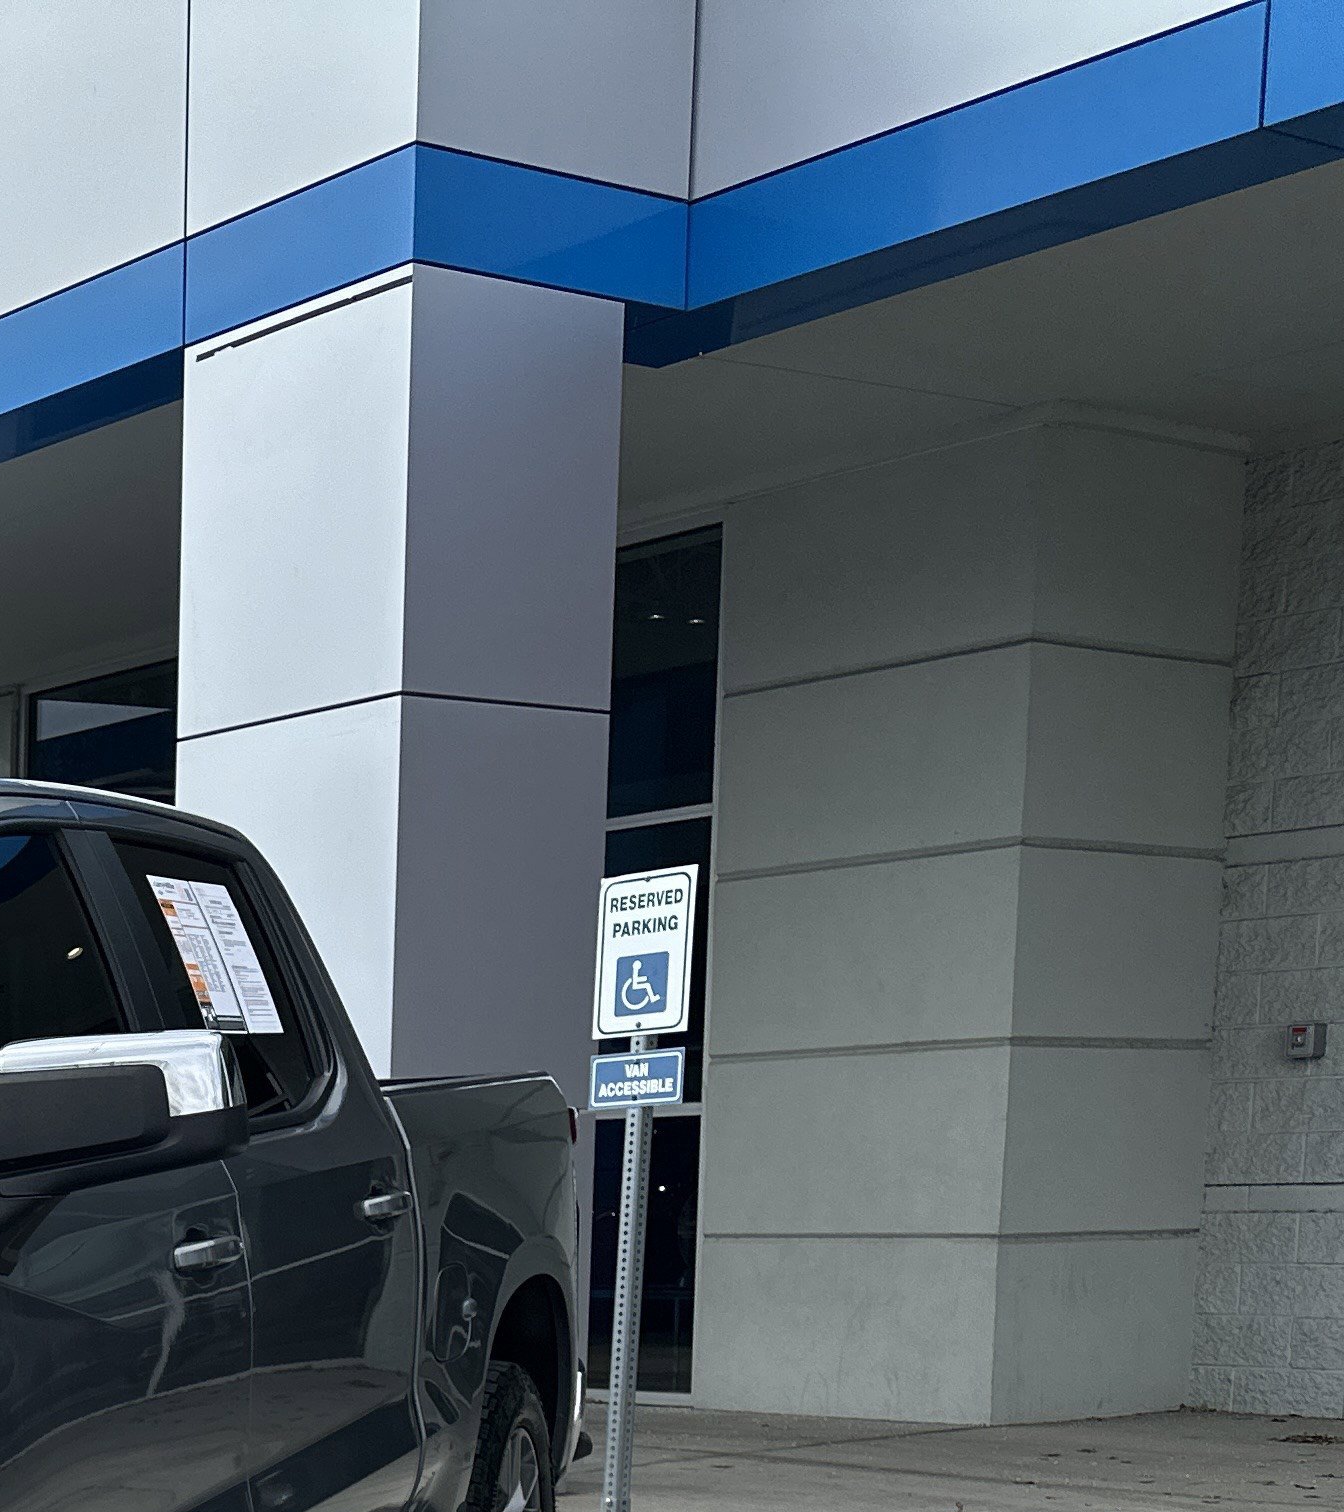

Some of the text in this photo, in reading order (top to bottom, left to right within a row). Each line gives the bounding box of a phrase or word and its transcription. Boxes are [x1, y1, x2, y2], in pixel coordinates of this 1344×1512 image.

[610, 888, 684, 913] RESERVED
[612, 914, 679, 939] PARKING
[624, 1062, 649, 1078] VAN
[598, 1077, 674, 1098] ACCESSIBLE
